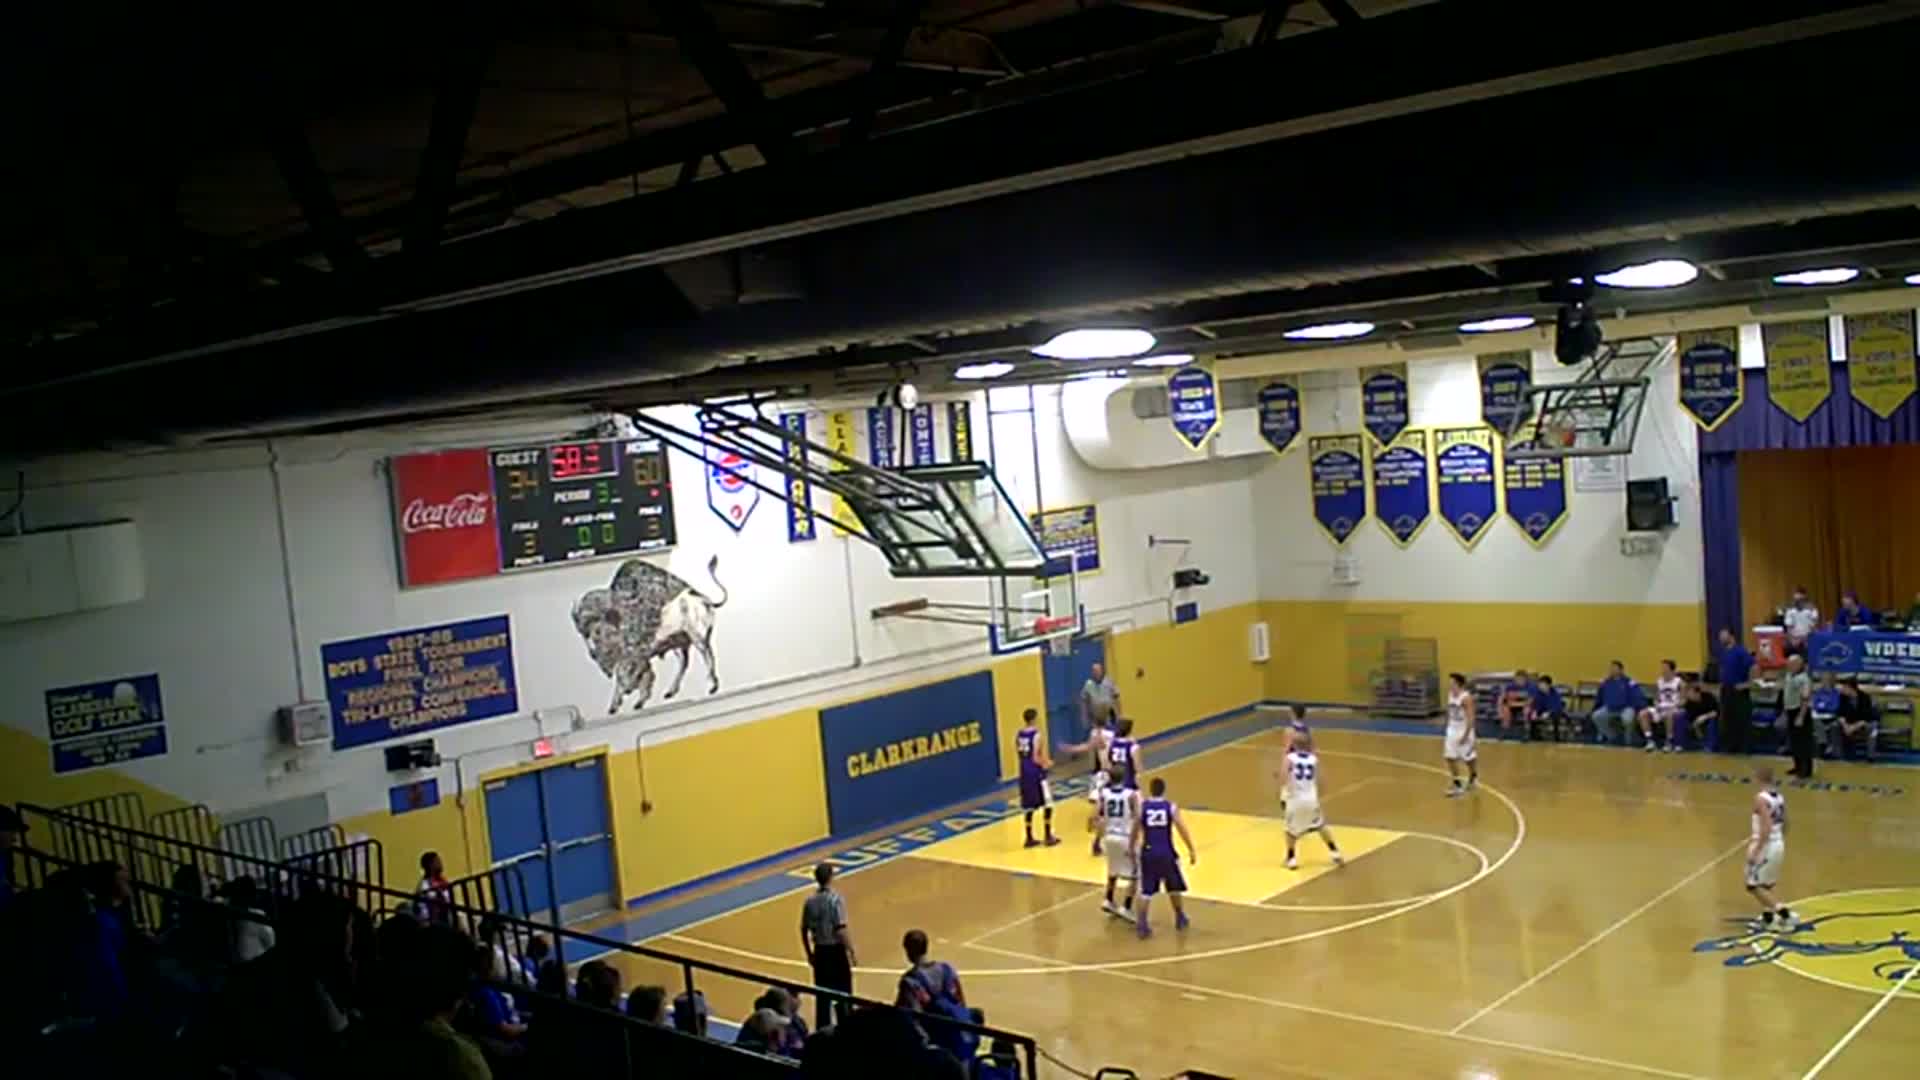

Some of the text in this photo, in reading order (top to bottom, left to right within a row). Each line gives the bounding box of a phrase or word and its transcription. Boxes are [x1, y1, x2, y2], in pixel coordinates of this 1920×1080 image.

[496, 450, 540, 466] GUEST
[402, 492, 488, 534] Coca-Cola
[846, 721, 982, 779] CLARKRANGE
[1145, 808, 1168, 827] 23
